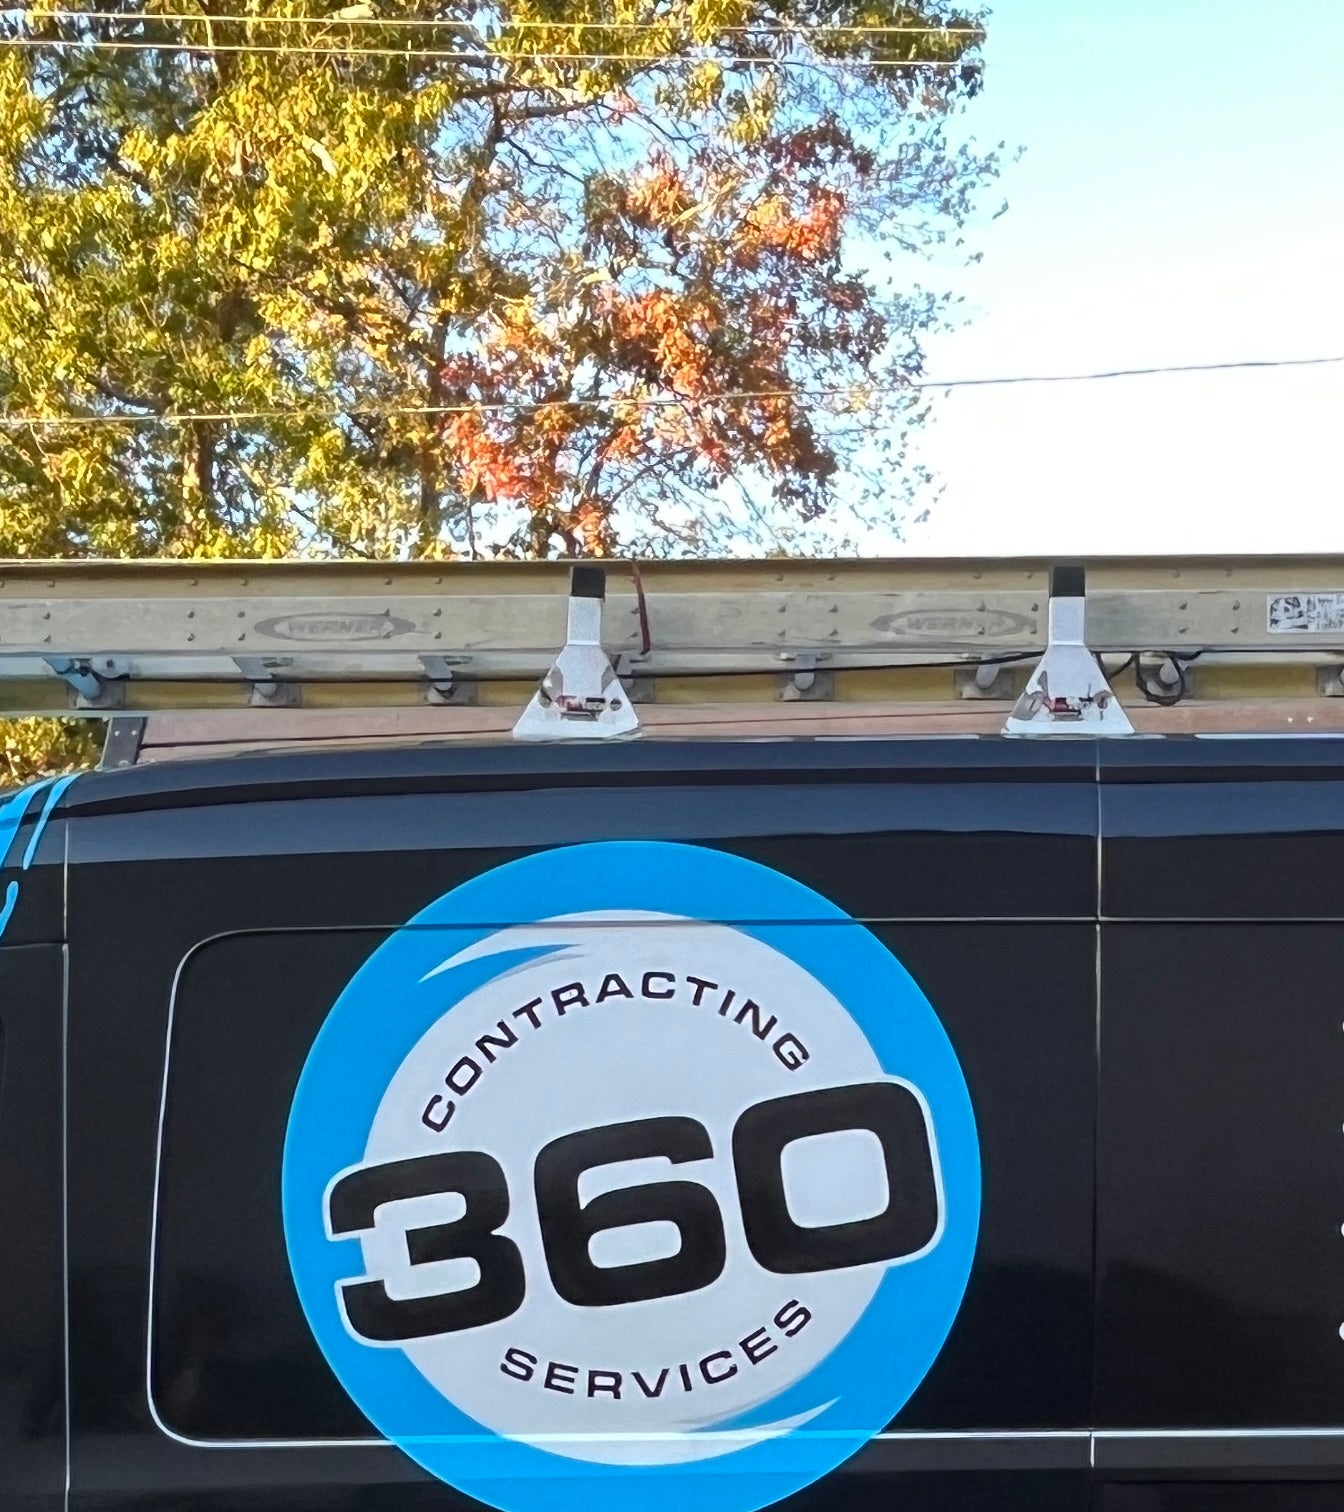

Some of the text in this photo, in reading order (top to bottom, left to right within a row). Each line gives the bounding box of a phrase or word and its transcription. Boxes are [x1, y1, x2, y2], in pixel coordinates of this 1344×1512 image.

[421, 970, 810, 1133] CONTRACTING
[328, 1080, 941, 1342] 360
[499, 1298, 812, 1400] SERVICES
